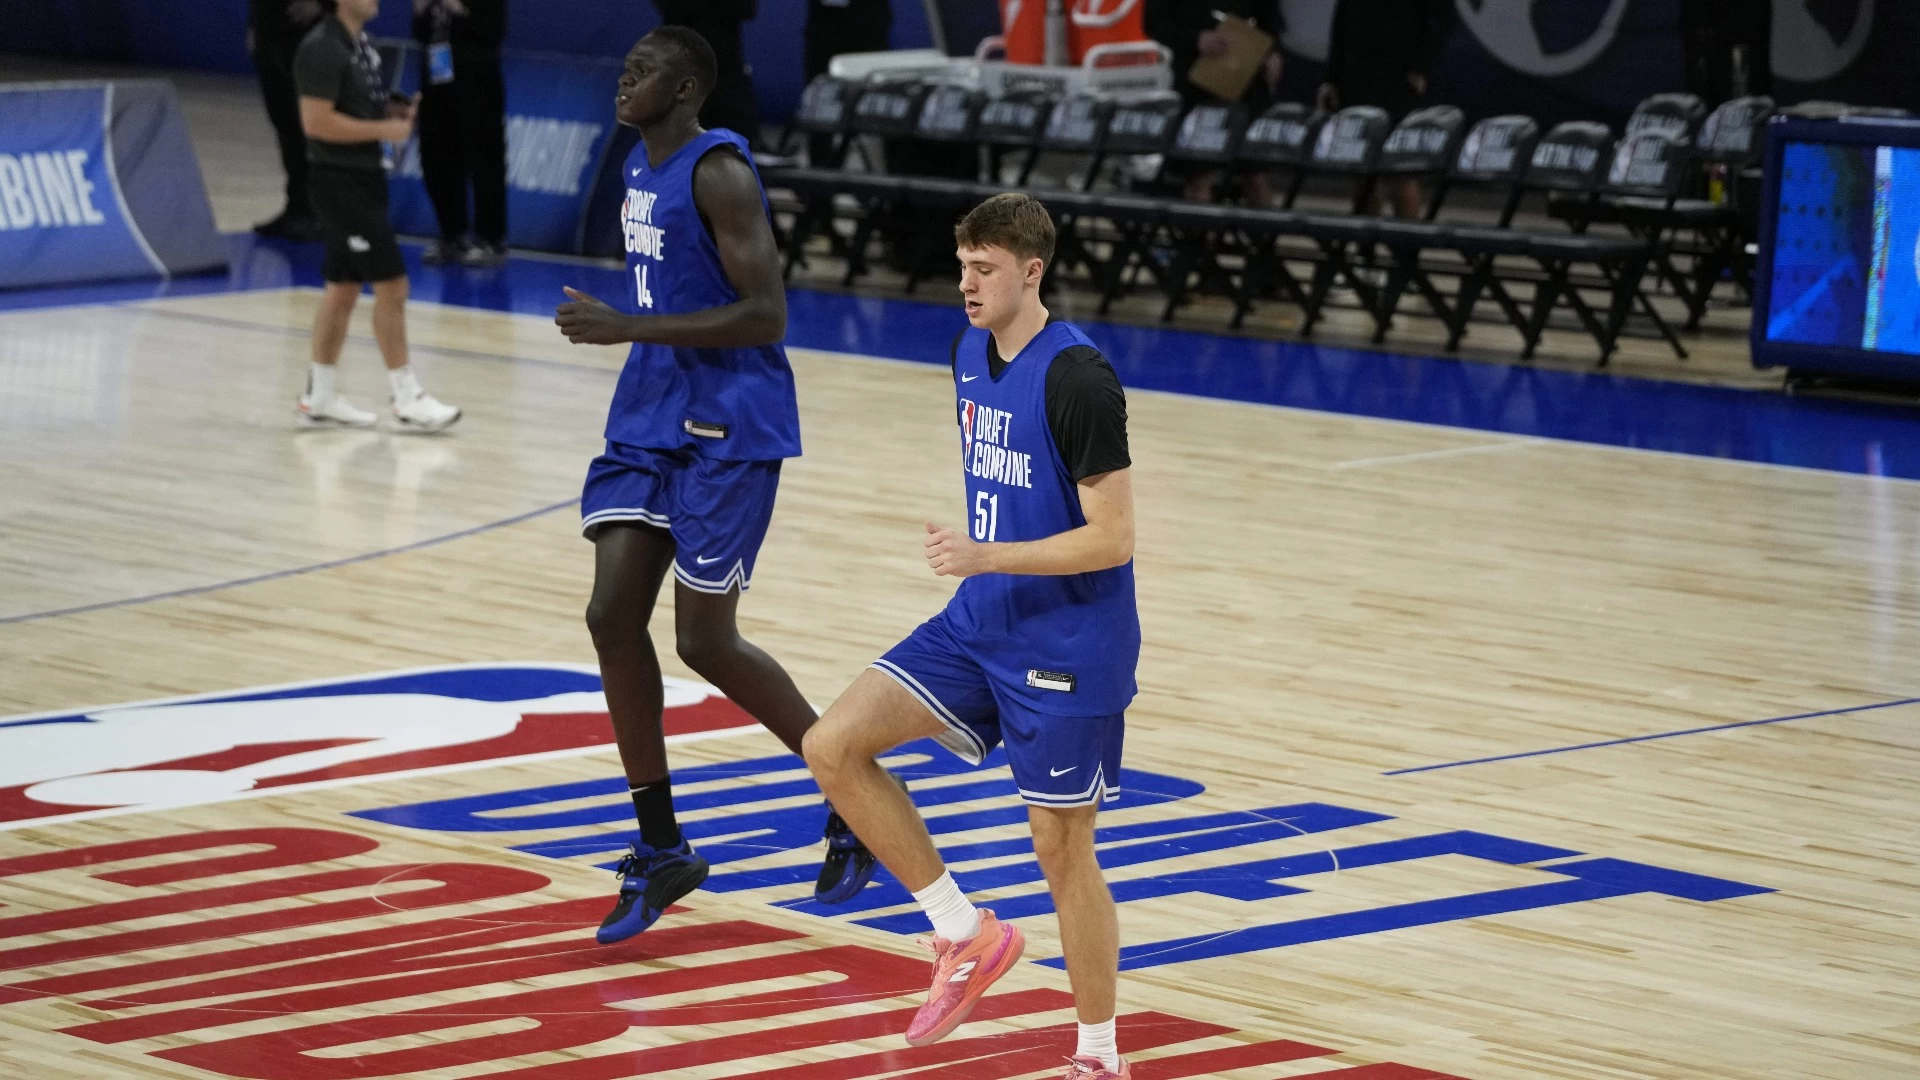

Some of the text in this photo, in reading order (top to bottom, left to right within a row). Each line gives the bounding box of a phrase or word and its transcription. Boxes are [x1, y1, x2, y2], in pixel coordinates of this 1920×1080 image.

[0, 149, 106, 230] BINE
[627, 189, 657, 224] DRAFT
[634, 264, 653, 309] 14
[975, 404, 1013, 448] DRAFT
[972, 441, 1033, 489] COMBINE
[974, 490, 998, 542] 51
